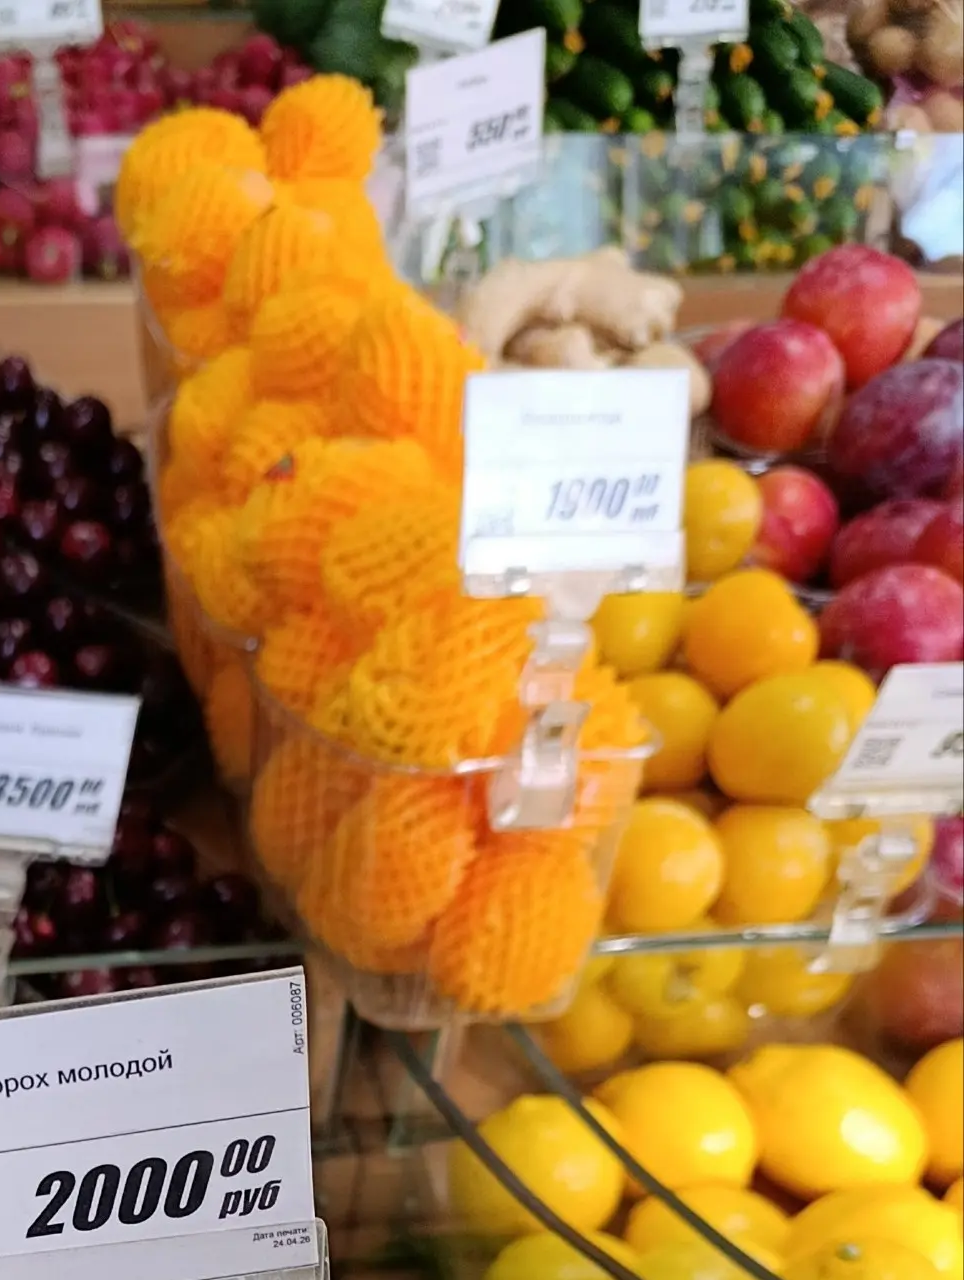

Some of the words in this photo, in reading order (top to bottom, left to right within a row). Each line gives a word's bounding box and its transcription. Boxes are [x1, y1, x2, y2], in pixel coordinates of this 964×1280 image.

[289, 981, 303, 1026] 006087
[57, 1049, 173, 1085] молодой
[26, 1150, 215, 1238] 2000
[220, 1135, 276, 1177] 00
[218, 1179, 283, 1220] руб
[252, 1231, 275, 1243] Дата
